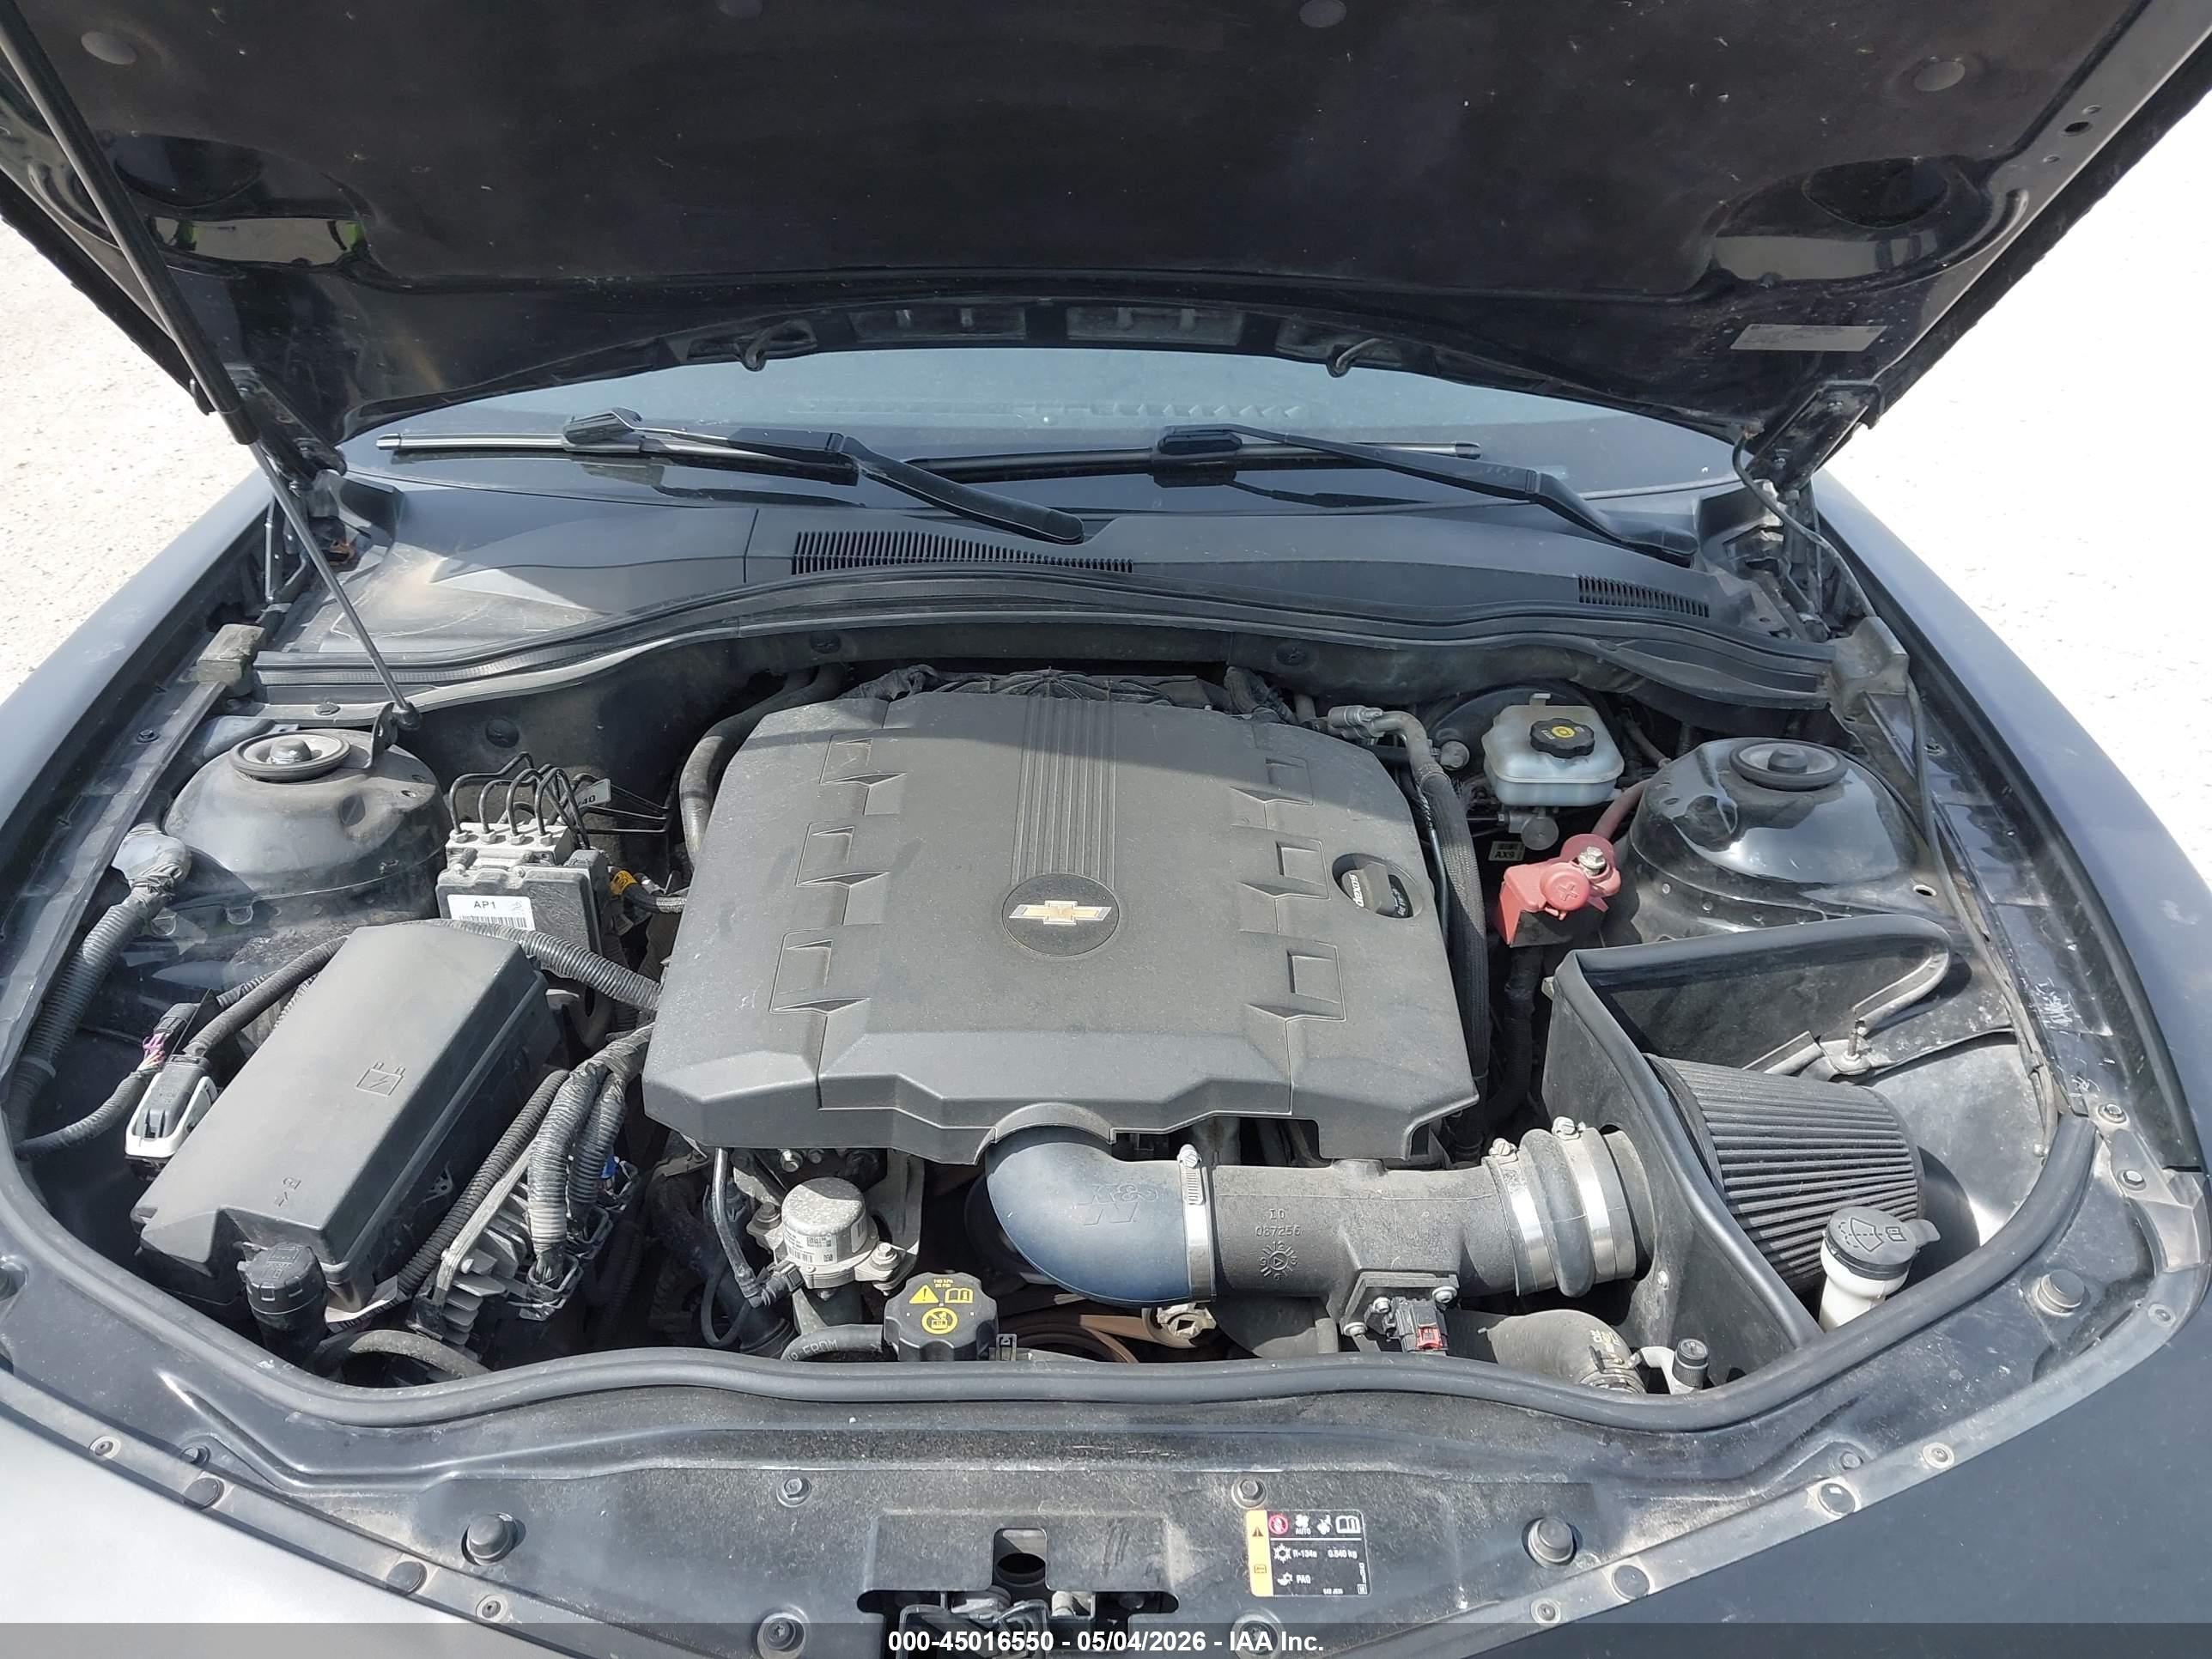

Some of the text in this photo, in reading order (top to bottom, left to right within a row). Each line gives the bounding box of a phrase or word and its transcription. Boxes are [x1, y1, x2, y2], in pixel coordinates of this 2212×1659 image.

[578, 794, 596, 805] 40
[1348, 872, 1364, 908] dexos
[473, 900, 496, 909] AP1
